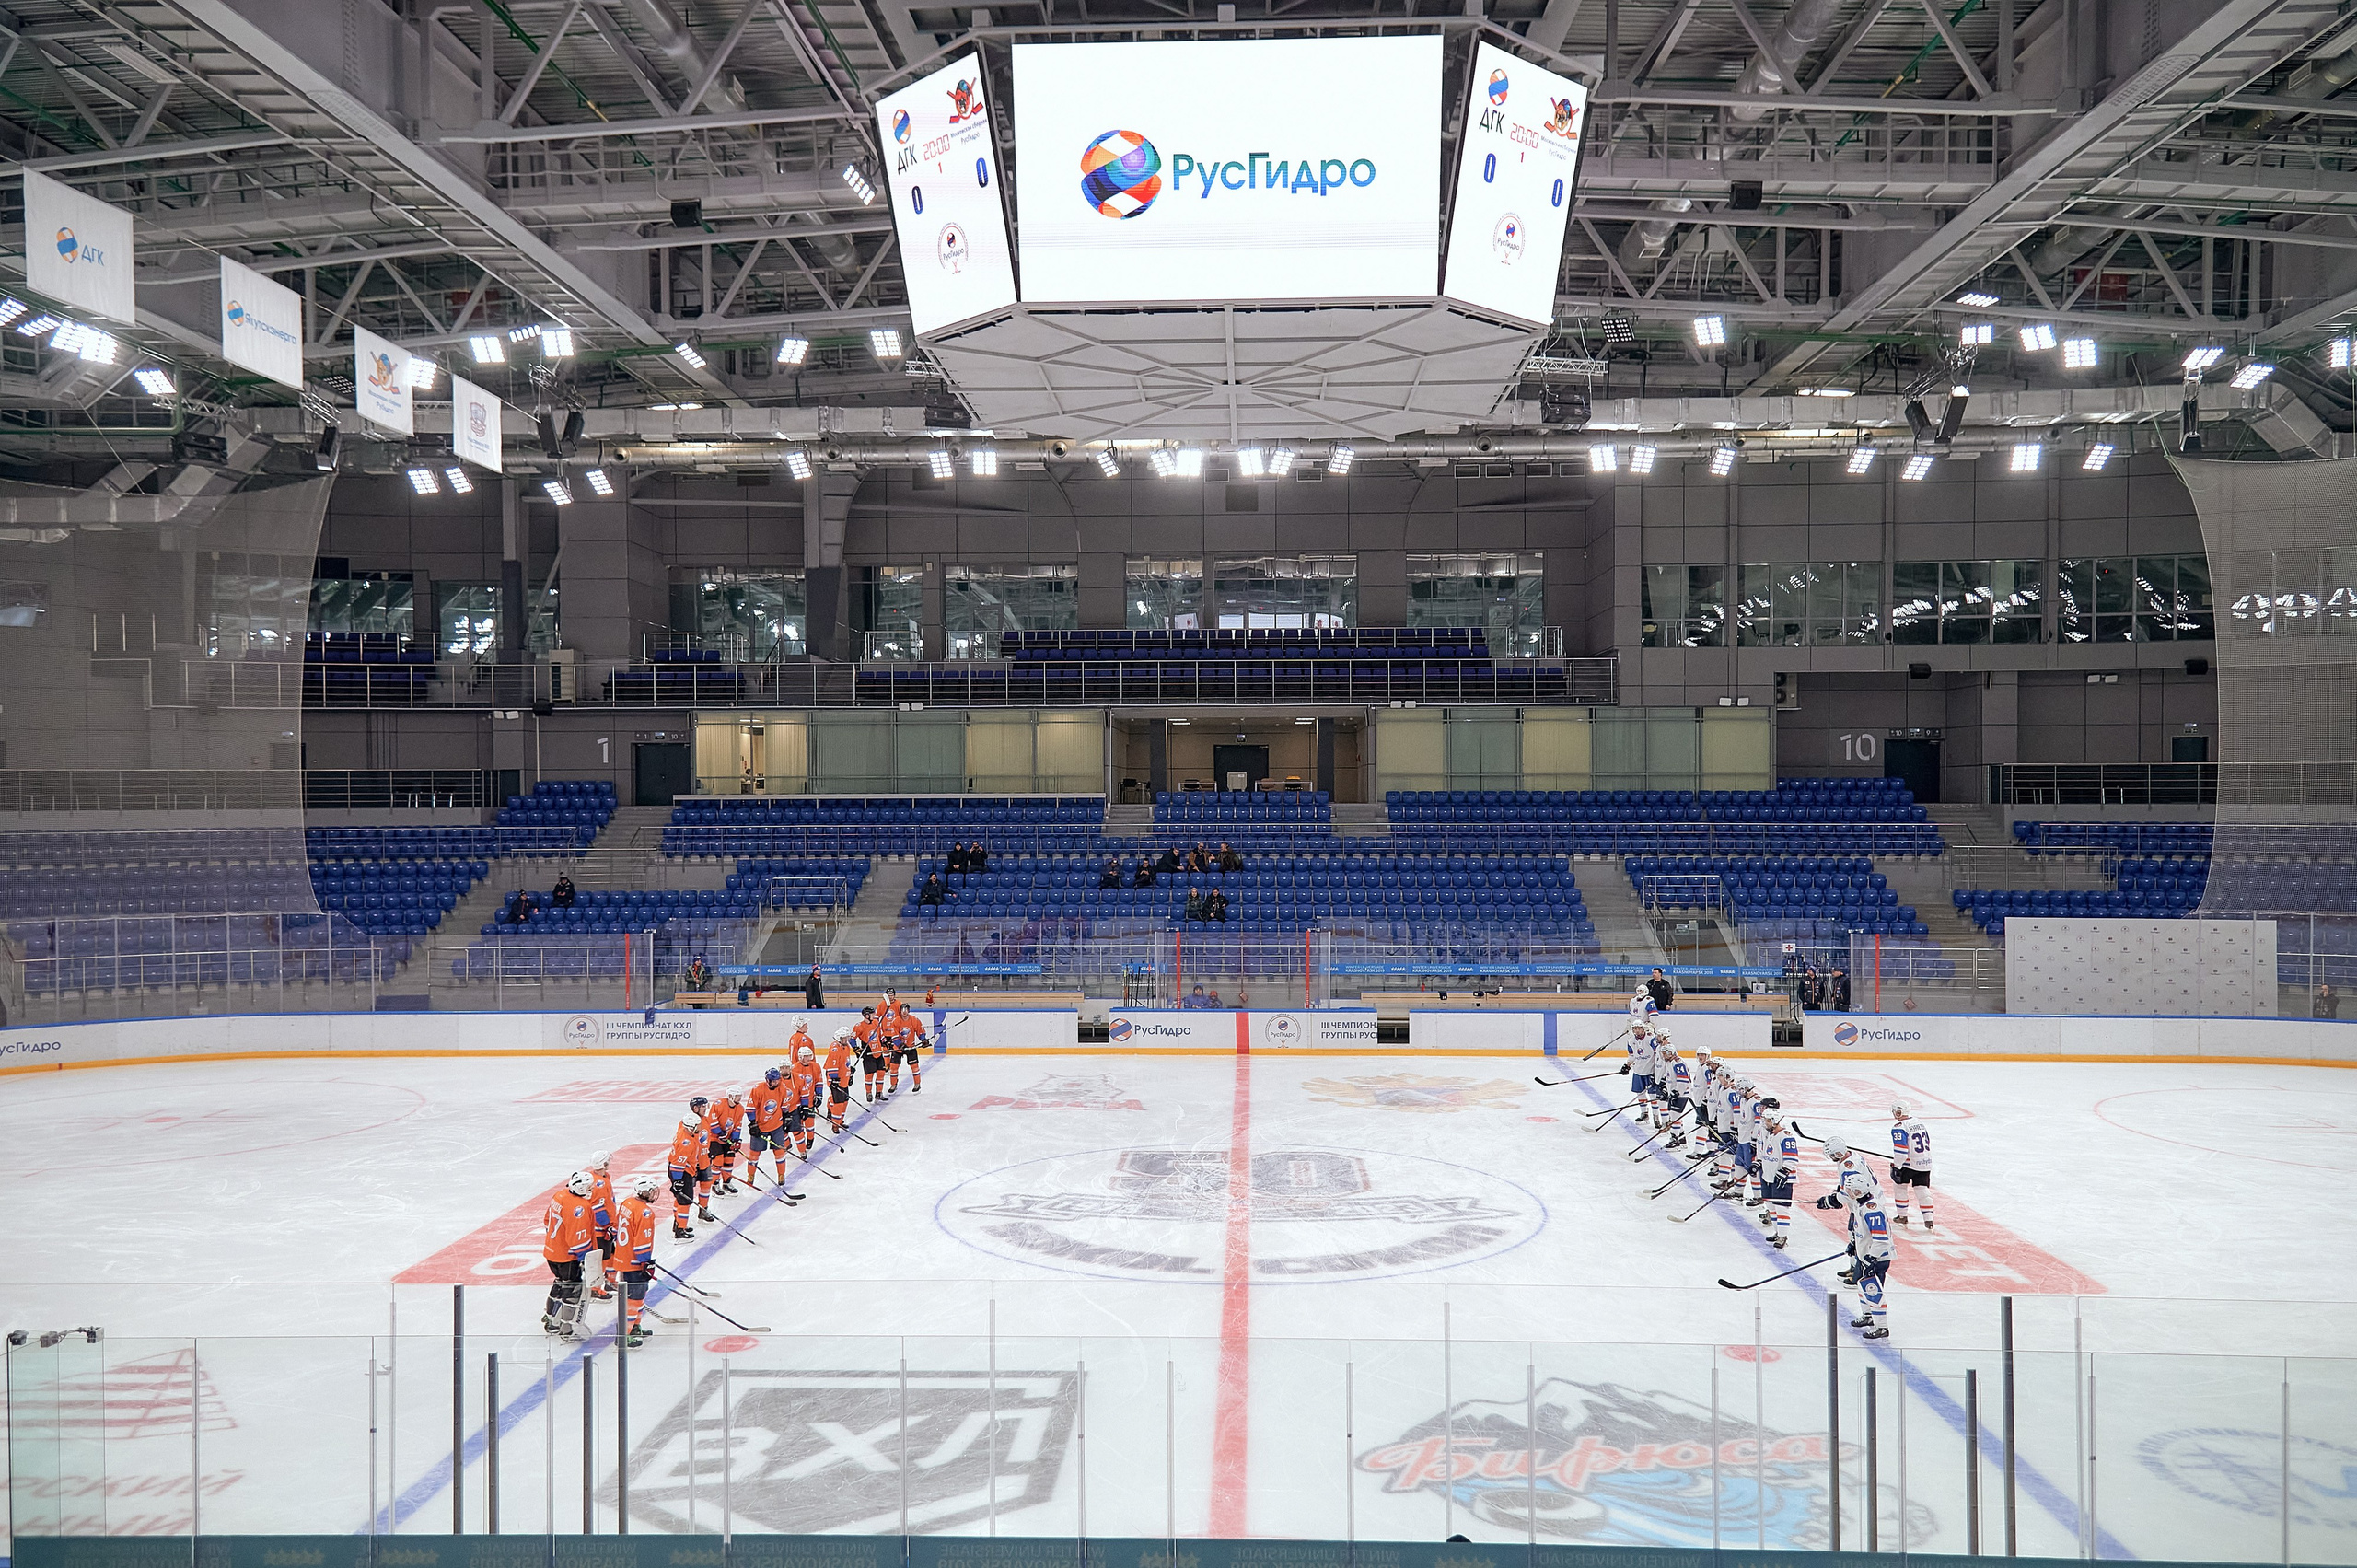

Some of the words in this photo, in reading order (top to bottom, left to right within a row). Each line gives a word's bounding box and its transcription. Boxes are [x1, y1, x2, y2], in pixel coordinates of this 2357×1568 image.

[1479, 107, 1505, 134] ДГК
[923, 134, 951, 161] 20:00
[1510, 122, 1539, 149] 20:00
[898, 144, 918, 175] ДГК
[938, 161, 943, 174] 1
[1483, 153, 1496, 183] 0
[1520, 152, 1525, 163] 1
[976, 157, 989, 188] 0
[1173, 152, 1376, 199] РусГидро
[911, 185, 923, 215] 0
[1551, 178, 1563, 207] 0
[81, 244, 105, 266] ДГК
[943, 248, 964, 261] РусГидро
[1497, 237, 1519, 250] РусГидро
[597, 737, 609, 763] 1
[1840, 733, 1876, 761] 10
[644, 1032, 691, 1040] РУСГИДРО
[1134, 1024, 1191, 1038] РусГидро
[1320, 1021, 1329, 1029] III
[1861, 1028, 1921, 1042] РусГидро
[1894, 1132, 1902, 1141] 33
[1912, 1133, 1931, 1154] 33
[1869, 1215, 1882, 1226] 77
[575, 1228, 587, 1241] 77
[628, 1407, 1052, 1490] ВХЛ
[1360, 1432, 1841, 1493] Бирюса
